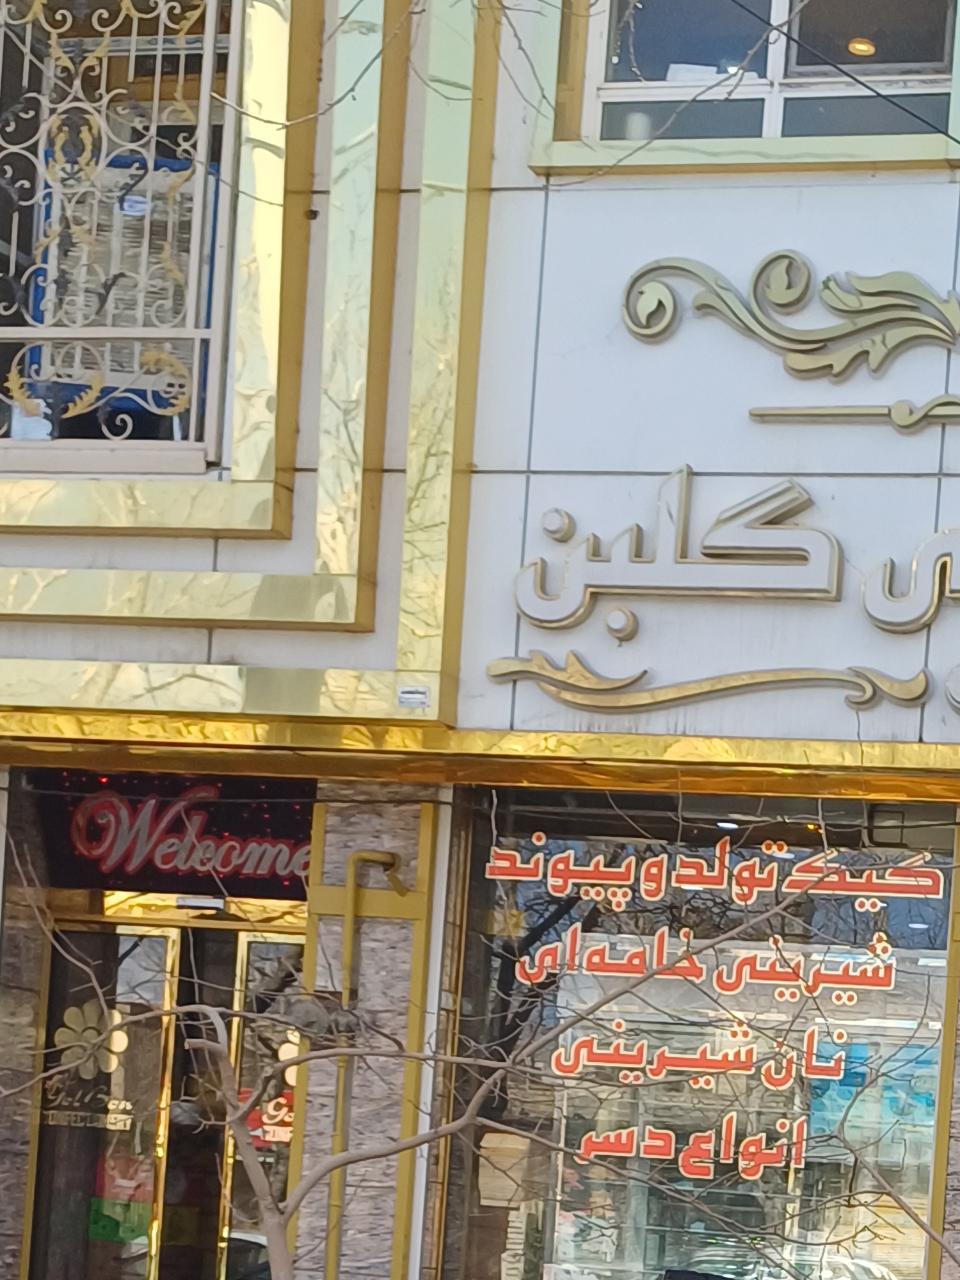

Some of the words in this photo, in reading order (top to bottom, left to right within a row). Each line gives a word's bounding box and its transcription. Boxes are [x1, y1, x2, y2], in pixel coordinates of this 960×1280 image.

[72, 785, 312, 877] Welcome
[485, 830, 637, 912] پیوند
[640, 850, 670, 901] و
[672, 835, 787, 905] تولد
[781, 847, 944, 912] کیک
[712, 932, 897, 1004] شیرینی
[551, 1018, 757, 1087] شیرینی
[763, 1025, 847, 1091] نان
[576, 1125, 676, 1164] دسر
[678, 1111, 808, 1180] انواع
